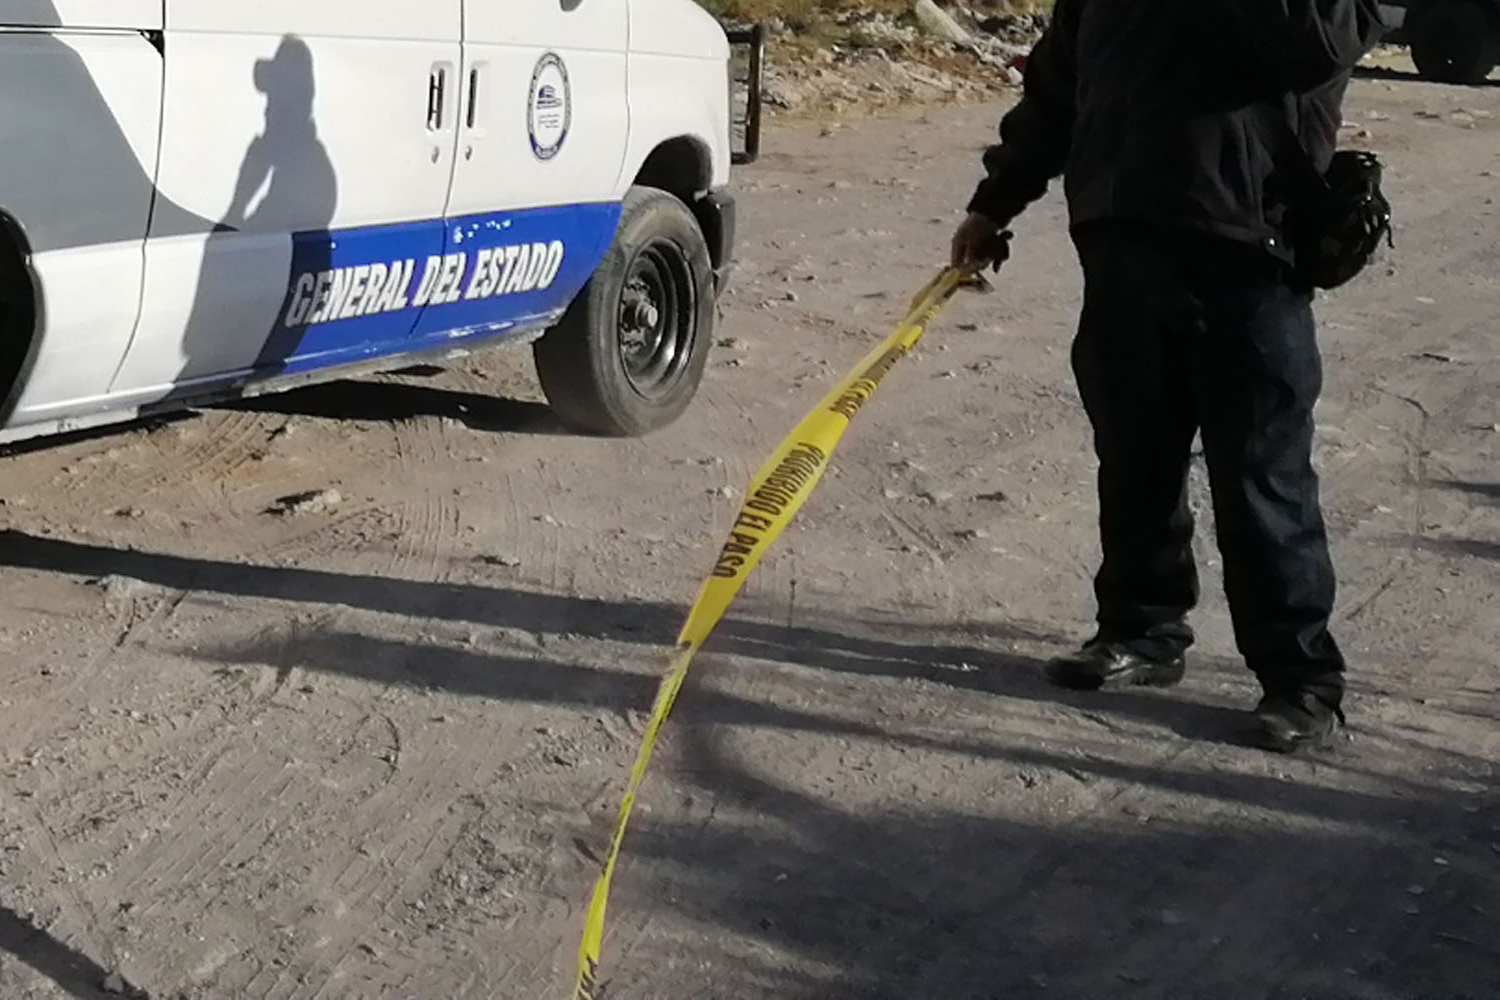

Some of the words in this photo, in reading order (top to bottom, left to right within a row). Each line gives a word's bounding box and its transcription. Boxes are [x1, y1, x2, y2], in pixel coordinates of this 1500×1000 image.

[284, 258, 415, 328] GENERAL
[412, 252, 467, 307] DEL
[464, 240, 565, 300] ESTADO
[744, 441, 826, 516] PROHIBIDO
[732, 511, 773, 533] EL
[711, 530, 760, 578] PASO
